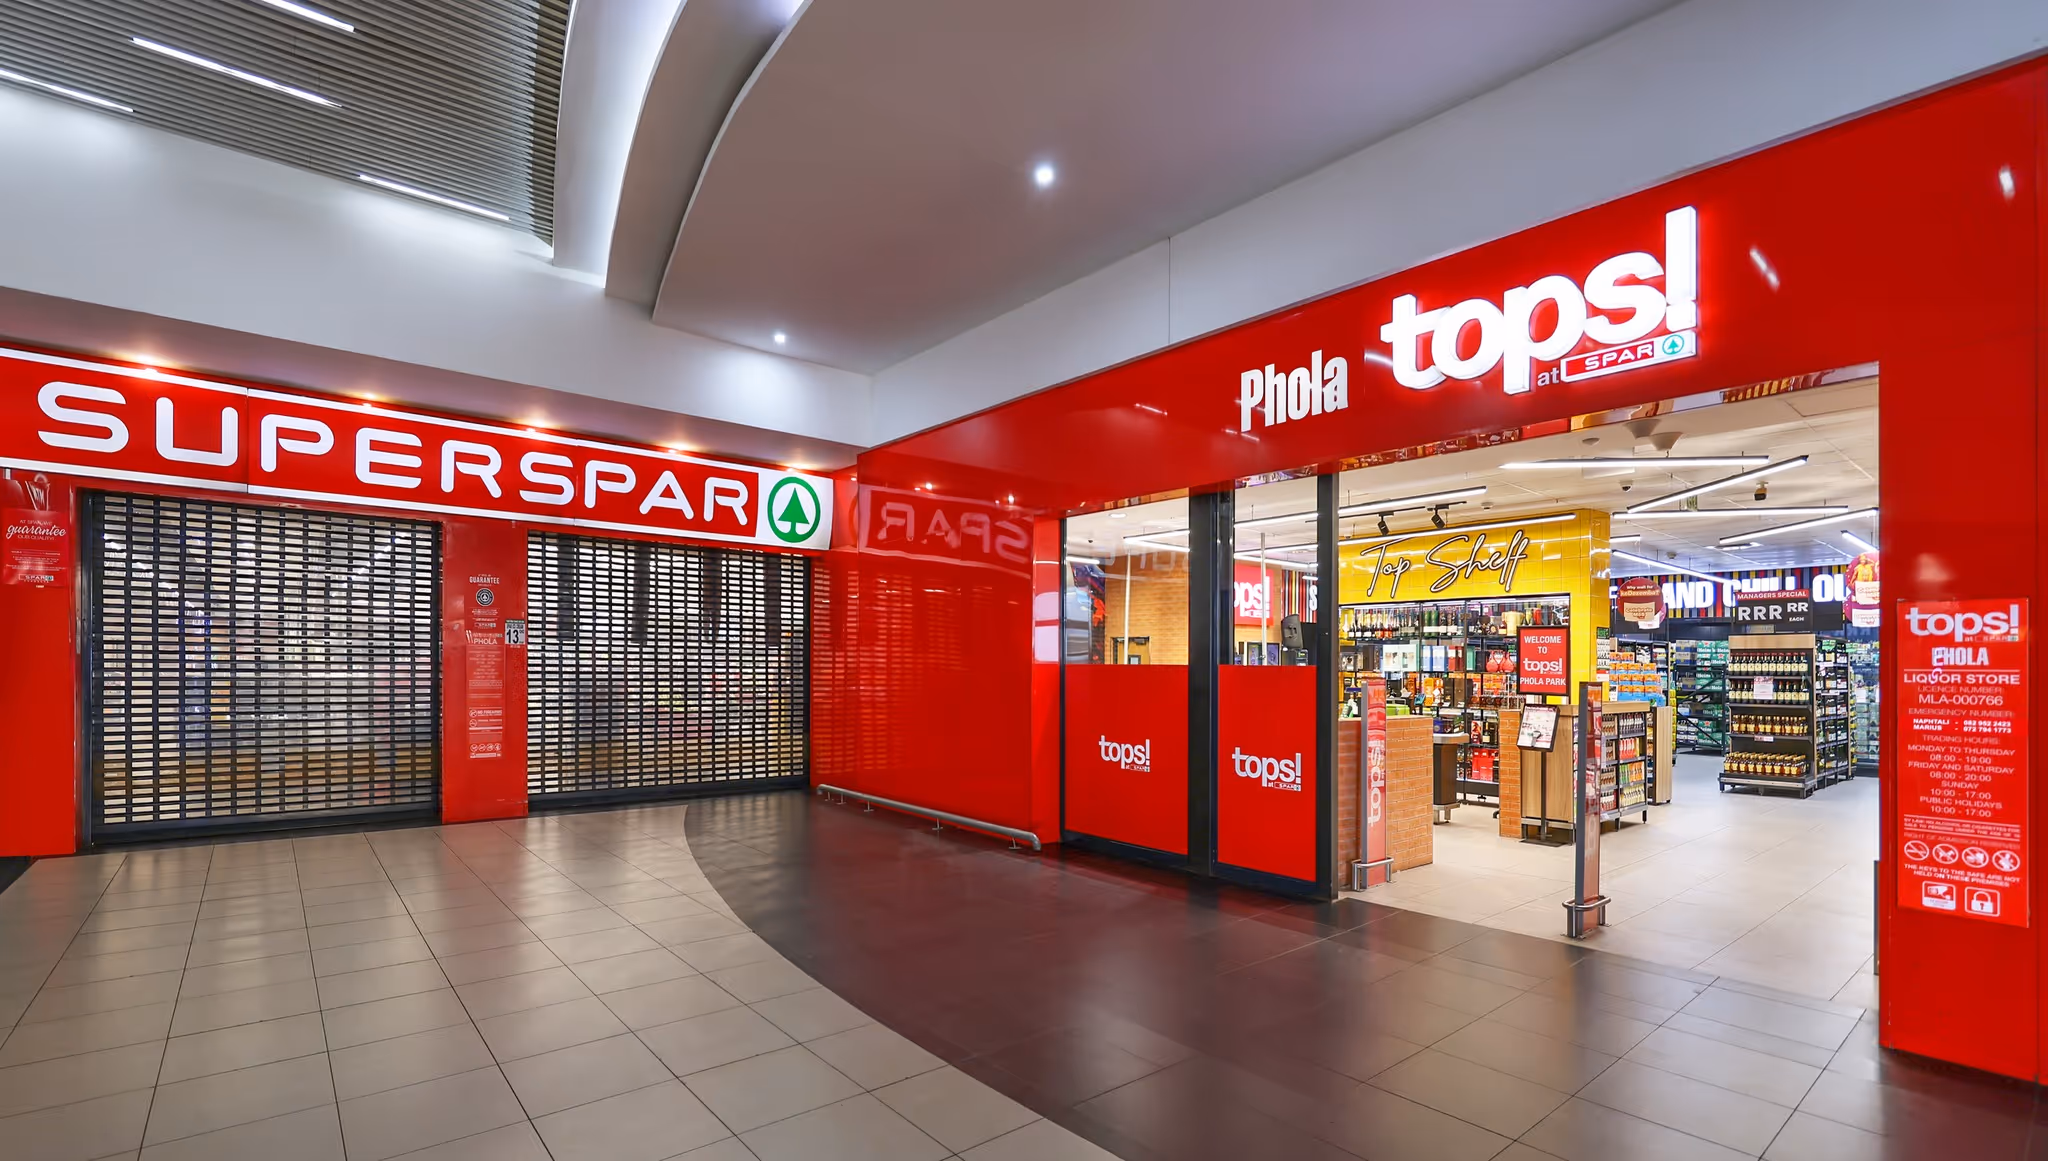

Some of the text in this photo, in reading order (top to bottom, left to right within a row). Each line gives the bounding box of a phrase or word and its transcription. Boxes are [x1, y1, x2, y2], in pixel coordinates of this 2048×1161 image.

[1380, 205, 1698, 395] tops!
[1537, 343, 1654, 387] at SPAR
[1241, 350, 1349, 432] Phola
[37, 380, 749, 525] SUPERSPAR
[6, 524, 67, 539] guarantee
[1360, 529, 1531, 598] Top Shelf
[469, 576, 500, 584] GUARANTEE
[1737, 591, 1777, 600] MANAGERS
[1904, 604, 2019, 642] tops!
[506, 629, 519, 644] 13
[1524, 635, 1562, 643] WELCOME
[1537, 646, 1548, 654] TO
[1522, 658, 1563, 675] tops!
[1520, 677, 1566, 686] PHOLA PARK
[1903, 673, 2021, 685] LIQUOR STORE
[1918, 694, 2003, 706] MLA-000766
[1908, 707, 1967, 716] EMERGENCY
[1922, 734, 1962, 743] TRADING
[1099, 735, 1150, 769] tops!
[1907, 744, 2016, 757] MONDAY TO THURSDAY
[1930, 753, 1955, 762] 08:00
[1965, 756, 1991, 765] 19:00
[1232, 747, 1302, 788] tops!
[1908, 761, 2015, 774] FRIDAY AND SATURDAY
[1965, 772, 1991, 782] 20:00
[1941, 780, 1979, 789] SUNDAY
[1930, 788, 1955, 797] 10:00
[1965, 791, 1991, 800] 17:00
[1920, 796, 2003, 809] PUBLIC HOLIDAYS
[1930, 805, 1955, 814] 10:00
[1965, 808, 1991, 817] 17:00
[1946, 874, 1970, 882] THESE
[1971, 877, 2010, 888] PREMISES
[2004, 875, 2020, 883] NOT
